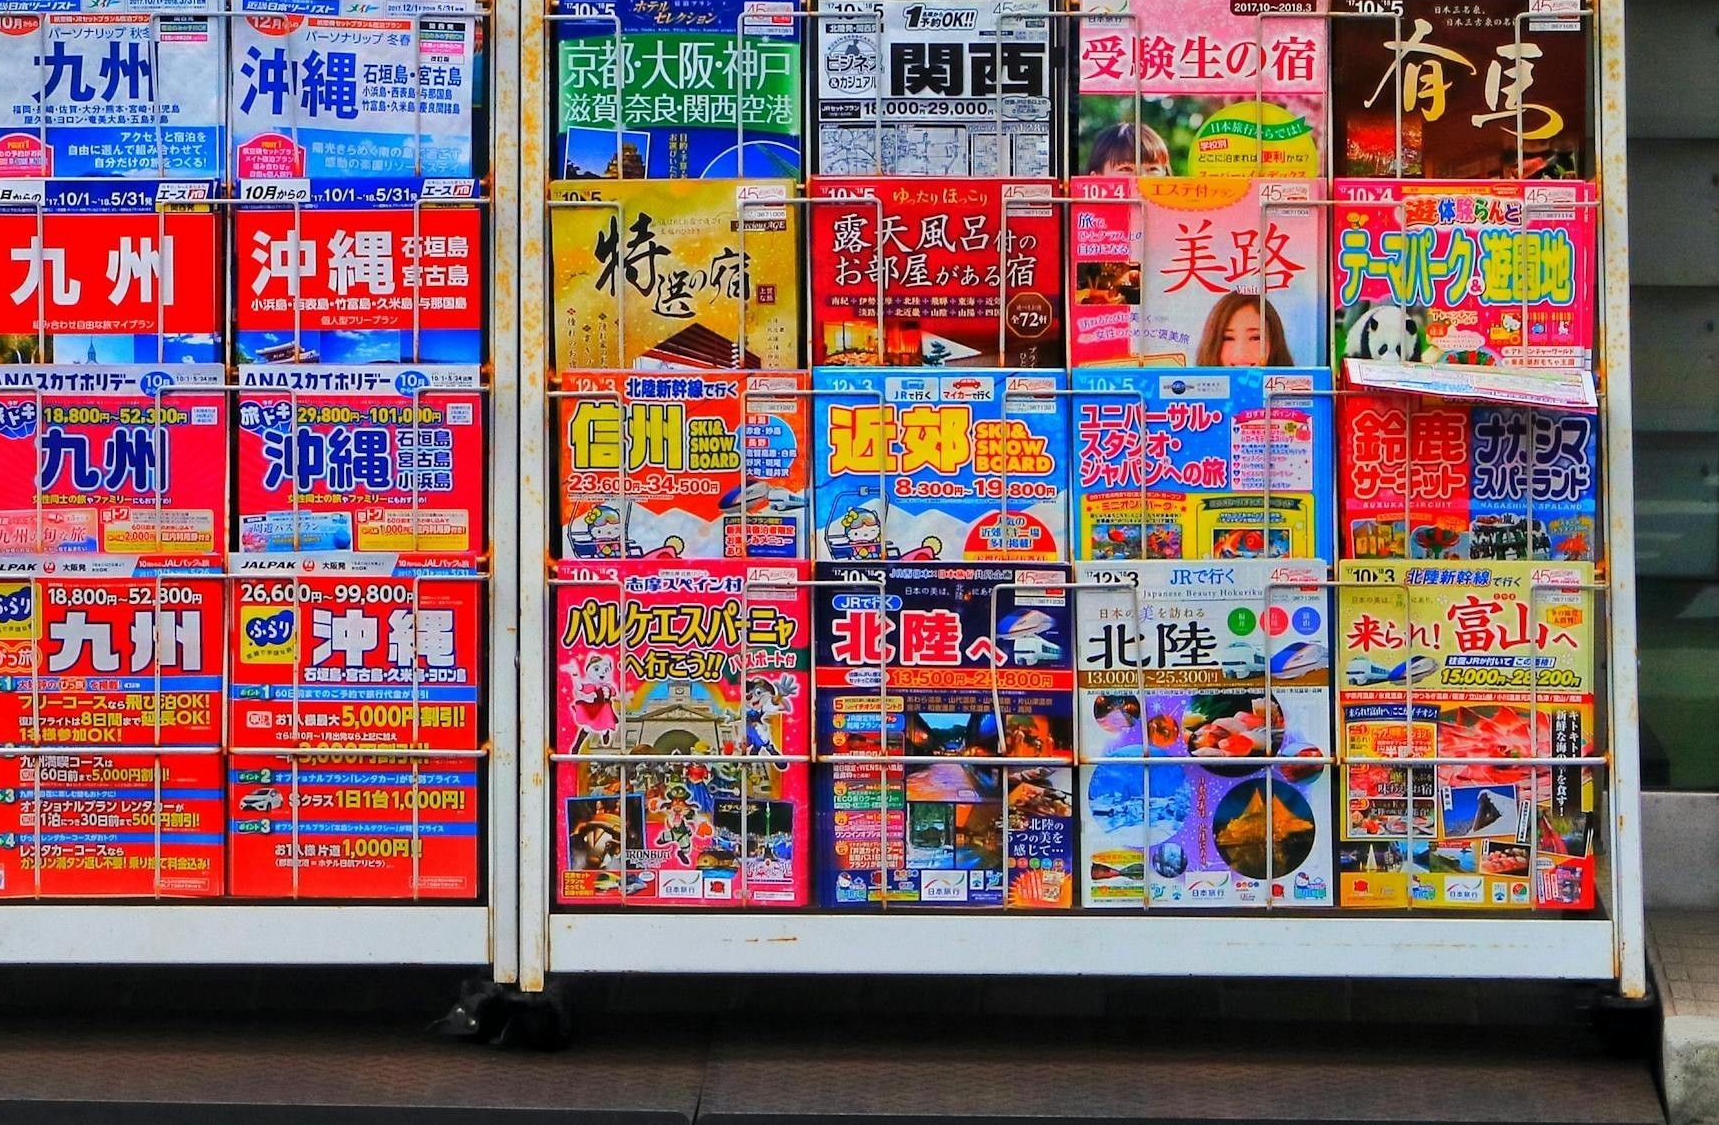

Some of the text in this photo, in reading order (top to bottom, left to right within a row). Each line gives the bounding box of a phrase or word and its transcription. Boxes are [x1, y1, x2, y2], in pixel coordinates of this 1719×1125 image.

[633, 1, 669, 15] ホテル
[48, 26, 124, 41] パーソナリップ
[306, 31, 384, 45] パーソナリップ
[564, 41, 792, 91] 京都・大阪・神戸
[890, 42, 1048, 98] 関西
[1081, 36, 1316, 83] 受験生の宿
[32, 41, 160, 104] 九州
[240, 46, 358, 119] 沖縄
[1365, 19, 1565, 141] 有馬
[1199, 139, 1228, 150] 学校別
[892, 188, 989, 206] ゆったり ほっこり
[401, 235, 469, 258] 石垣島
[1160, 219, 1308, 295] 美路
[10, 234, 174, 307] 九州
[250, 228, 395, 296] 沖縄
[244, 372, 391, 391] ANAスカイホリデー
[626, 379, 737, 398] 北陸新幹線で行く
[942, 389, 992, 401] マイカーで行く
[573, 405, 683, 471] 信州
[831, 405, 970, 474] 近郊
[1081, 432, 1181, 460] スタジオ・
[1353, 411, 1468, 465] 鈴鹿
[41, 427, 168, 491] 九州
[62, 562, 87, 572] 大阪発
[241, 560, 296, 570] JALPAK
[625, 576, 742, 593] 志摩スペイン村
[1170, 568, 1236, 586] JRで行く
[1406, 570, 1521, 588] 北陸新幹線で行く
[1143, 590, 1196, 599] Japanese
[251, 616, 295, 639] ふらり
[832, 610, 1007, 667] 北陸へ
